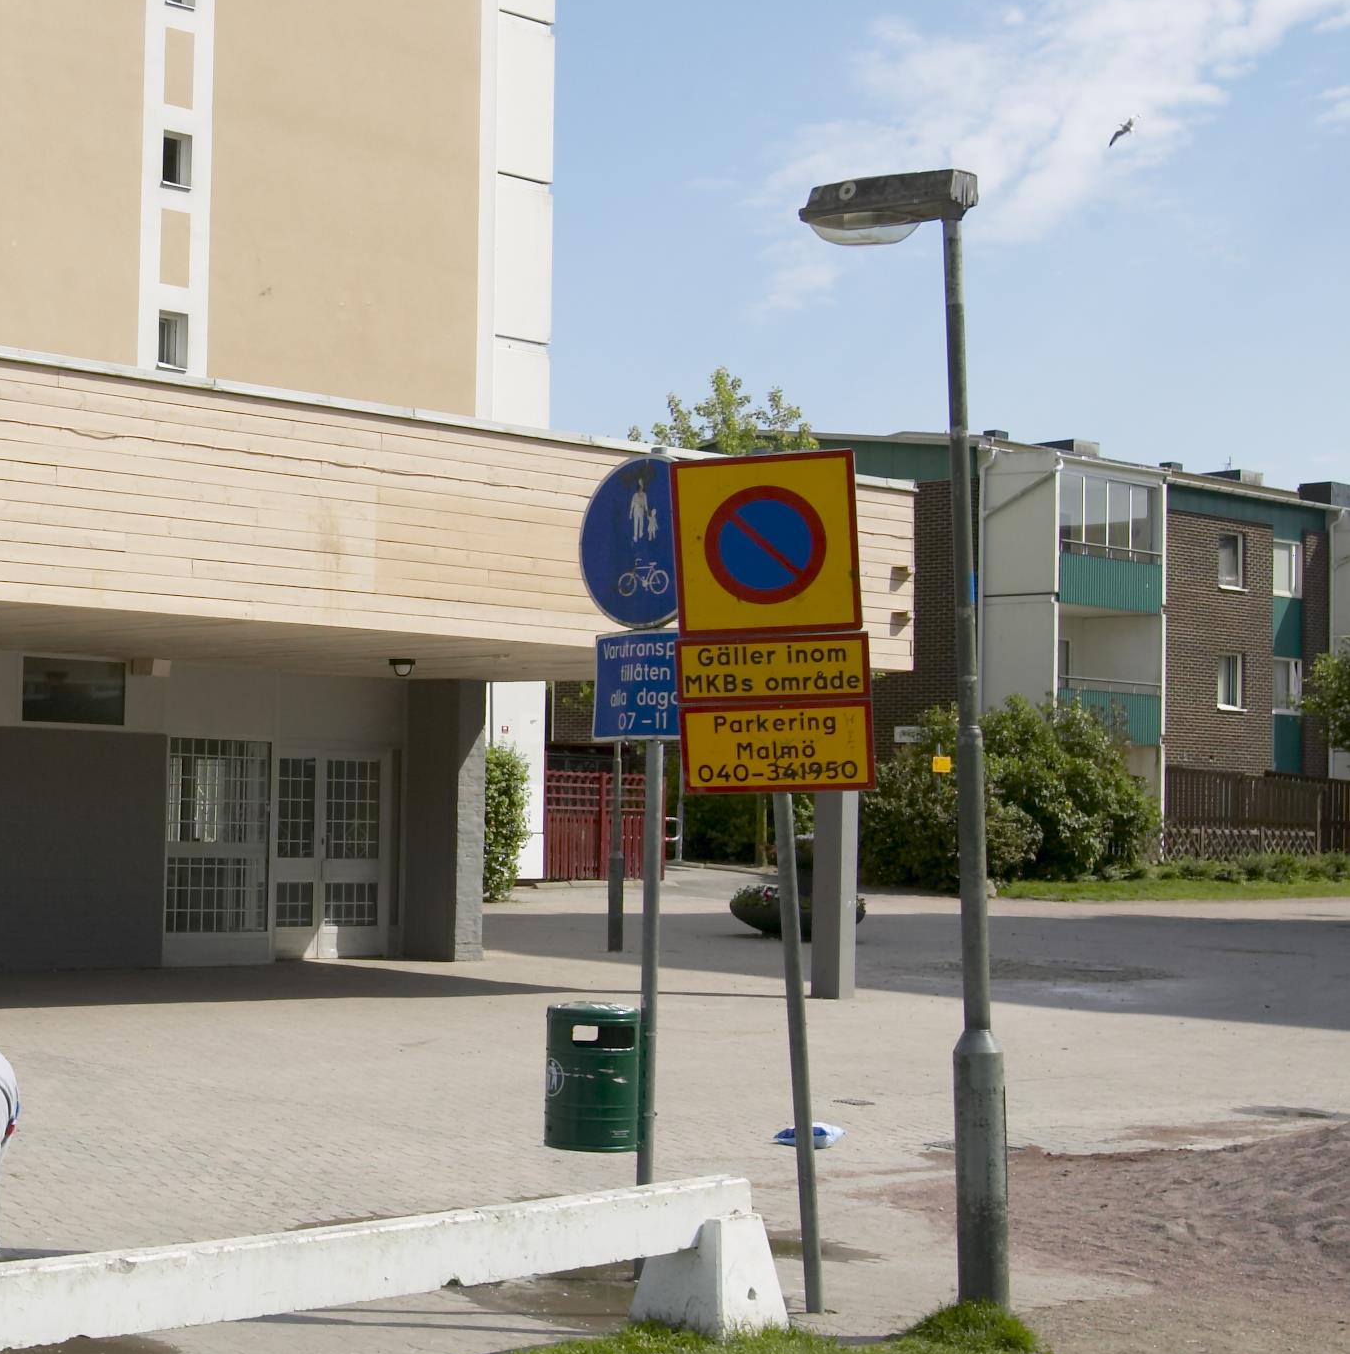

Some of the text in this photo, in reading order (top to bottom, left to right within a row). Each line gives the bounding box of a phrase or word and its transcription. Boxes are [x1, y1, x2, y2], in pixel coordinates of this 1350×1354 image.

[603, 641, 675, 660] Varutransp
[697, 645, 847, 667] Gäller inom
[620, 663, 671, 682] tillåten
[685, 671, 861, 694] MKBs område
[714, 712, 837, 734] Parkering
[737, 741, 816, 760] Malmö
